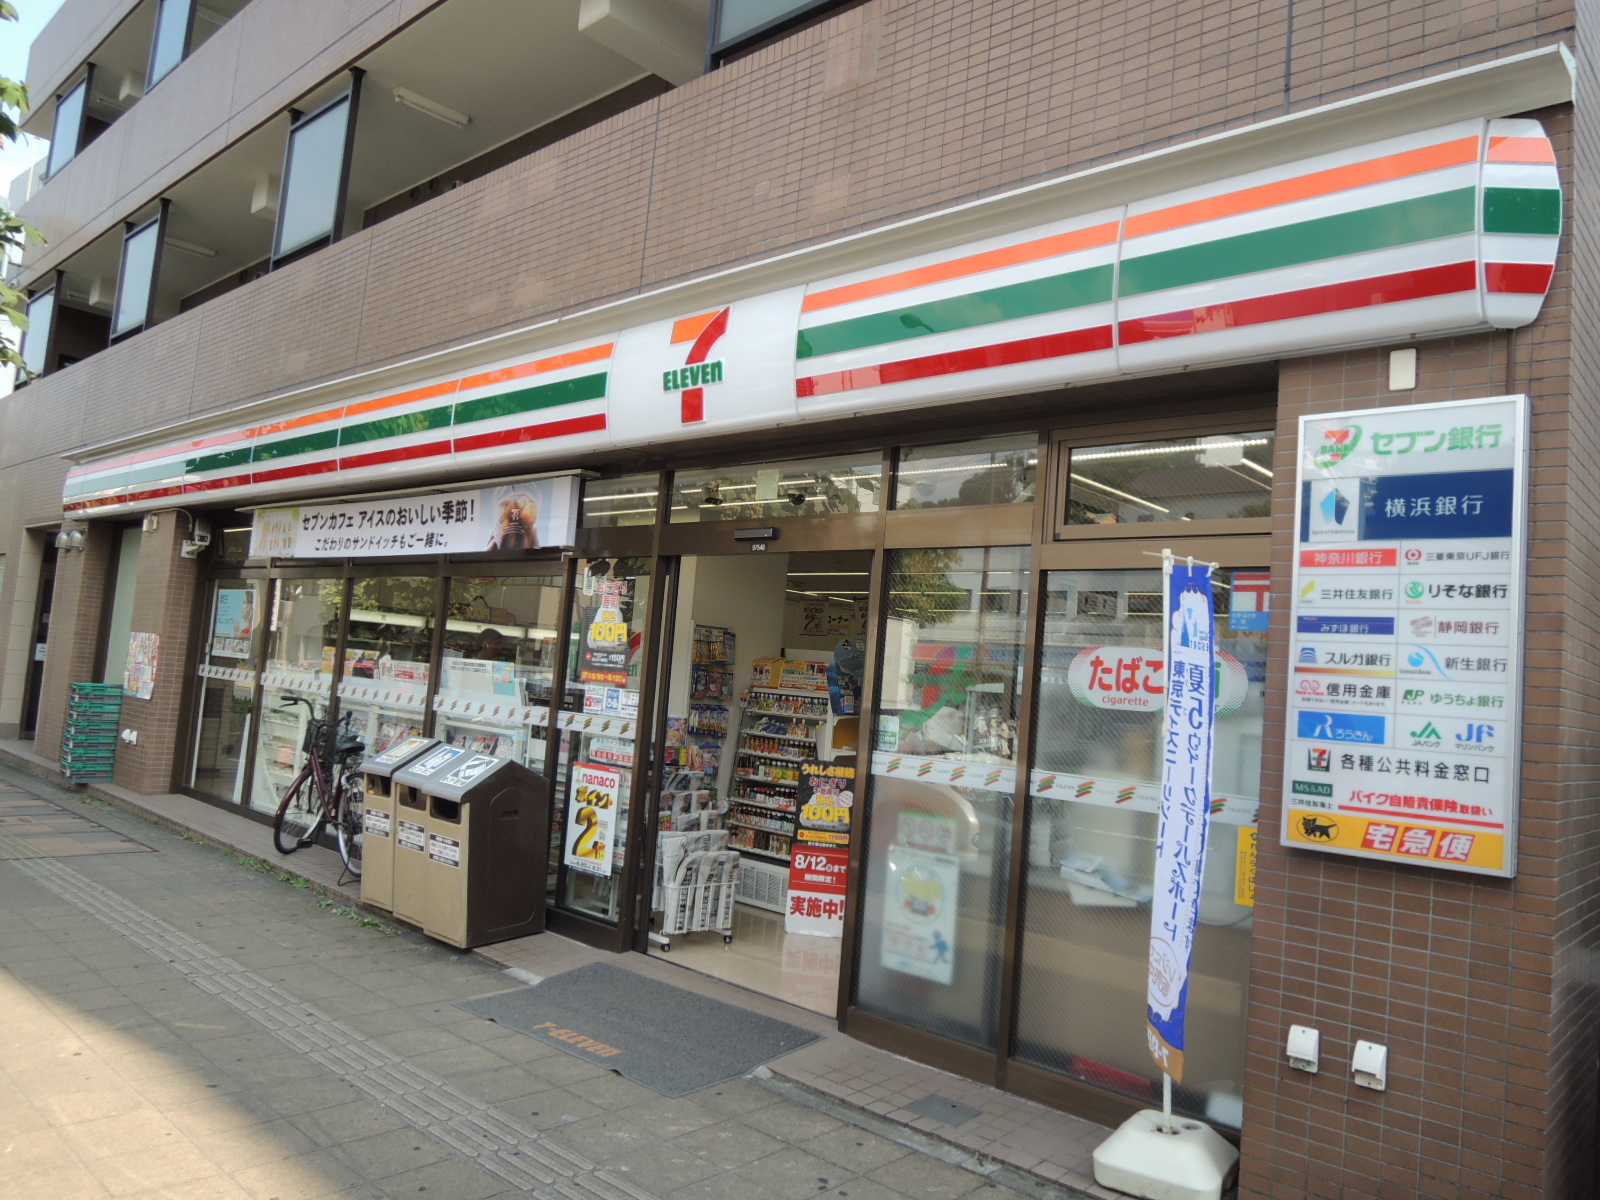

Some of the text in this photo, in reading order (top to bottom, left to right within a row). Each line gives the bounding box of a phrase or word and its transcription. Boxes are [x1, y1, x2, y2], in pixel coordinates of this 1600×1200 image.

[670, 305, 731, 424] 7
[1370, 423, 1502, 455] セブン銀行
[1385, 494, 1484, 518] 横浜銀行
[302, 499, 475, 531] セブンカフェ アイスのおいしい季節!
[314, 532, 449, 551] こだわりのサンドイッチもご一緒に。
[1313, 551, 1383, 565] 神奈川銀行
[1425, 550, 1511, 562] 三菱東京UFJ銀行
[1320, 588, 1394, 601] 三井住友銀行
[1428, 583, 1508, 599] りそな銀行
[590, 622, 628, 643] 100円
[1320, 623, 1370, 634] みずほ銀行
[1437, 620, 1500, 635] 静岡銀行
[1324, 651, 1391, 667] スルガ銀行
[1444, 657, 1508, 673] 新生銀行
[1089, 655, 1164, 694] たばこ
[1326, 682, 1391, 699] 信用金庫
[1102, 694, 1149, 707] cigarette
[1430, 693, 1504, 708] ゆうちょ銀行
[1335, 729, 1373, 742] ろうきん
[1412, 739, 1441, 748] JAバンク
[1455, 742, 1495, 753] マリンバンク
[1340, 753, 1490, 784] 各種公共料金窓口
[581, 772, 616, 790] nanaco
[808, 776, 848, 790] おにぎり
[1294, 782, 1331, 796] MS&AD
[815, 794, 835, 805] 税込
[1349, 790, 1493, 816] バイク自賠責保険取扱い
[801, 804, 850, 824] 100円
[572, 806, 599, 857] 2
[1363, 821, 1472, 861] 宅急便
[804, 873, 836, 884] 期間限定!
[790, 895, 844, 921] 実施中!
